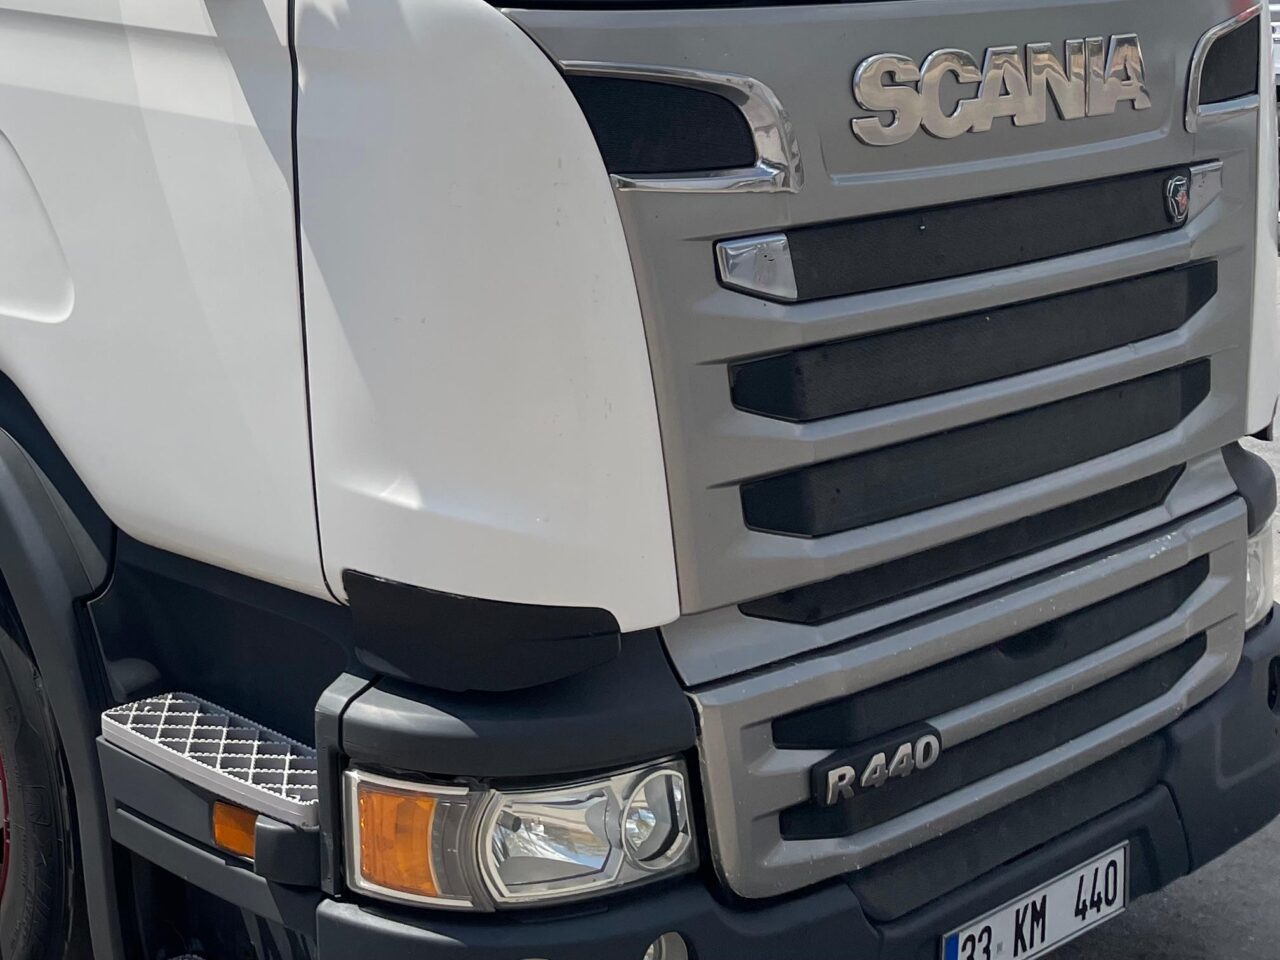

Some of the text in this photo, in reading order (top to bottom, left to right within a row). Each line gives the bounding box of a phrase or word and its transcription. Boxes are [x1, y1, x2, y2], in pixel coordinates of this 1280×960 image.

[850, 33, 1151, 146] SCANIA
[826, 734, 941, 806] R 440
[1013, 894, 1048, 958] KM
[1074, 859, 1118, 921] 440
